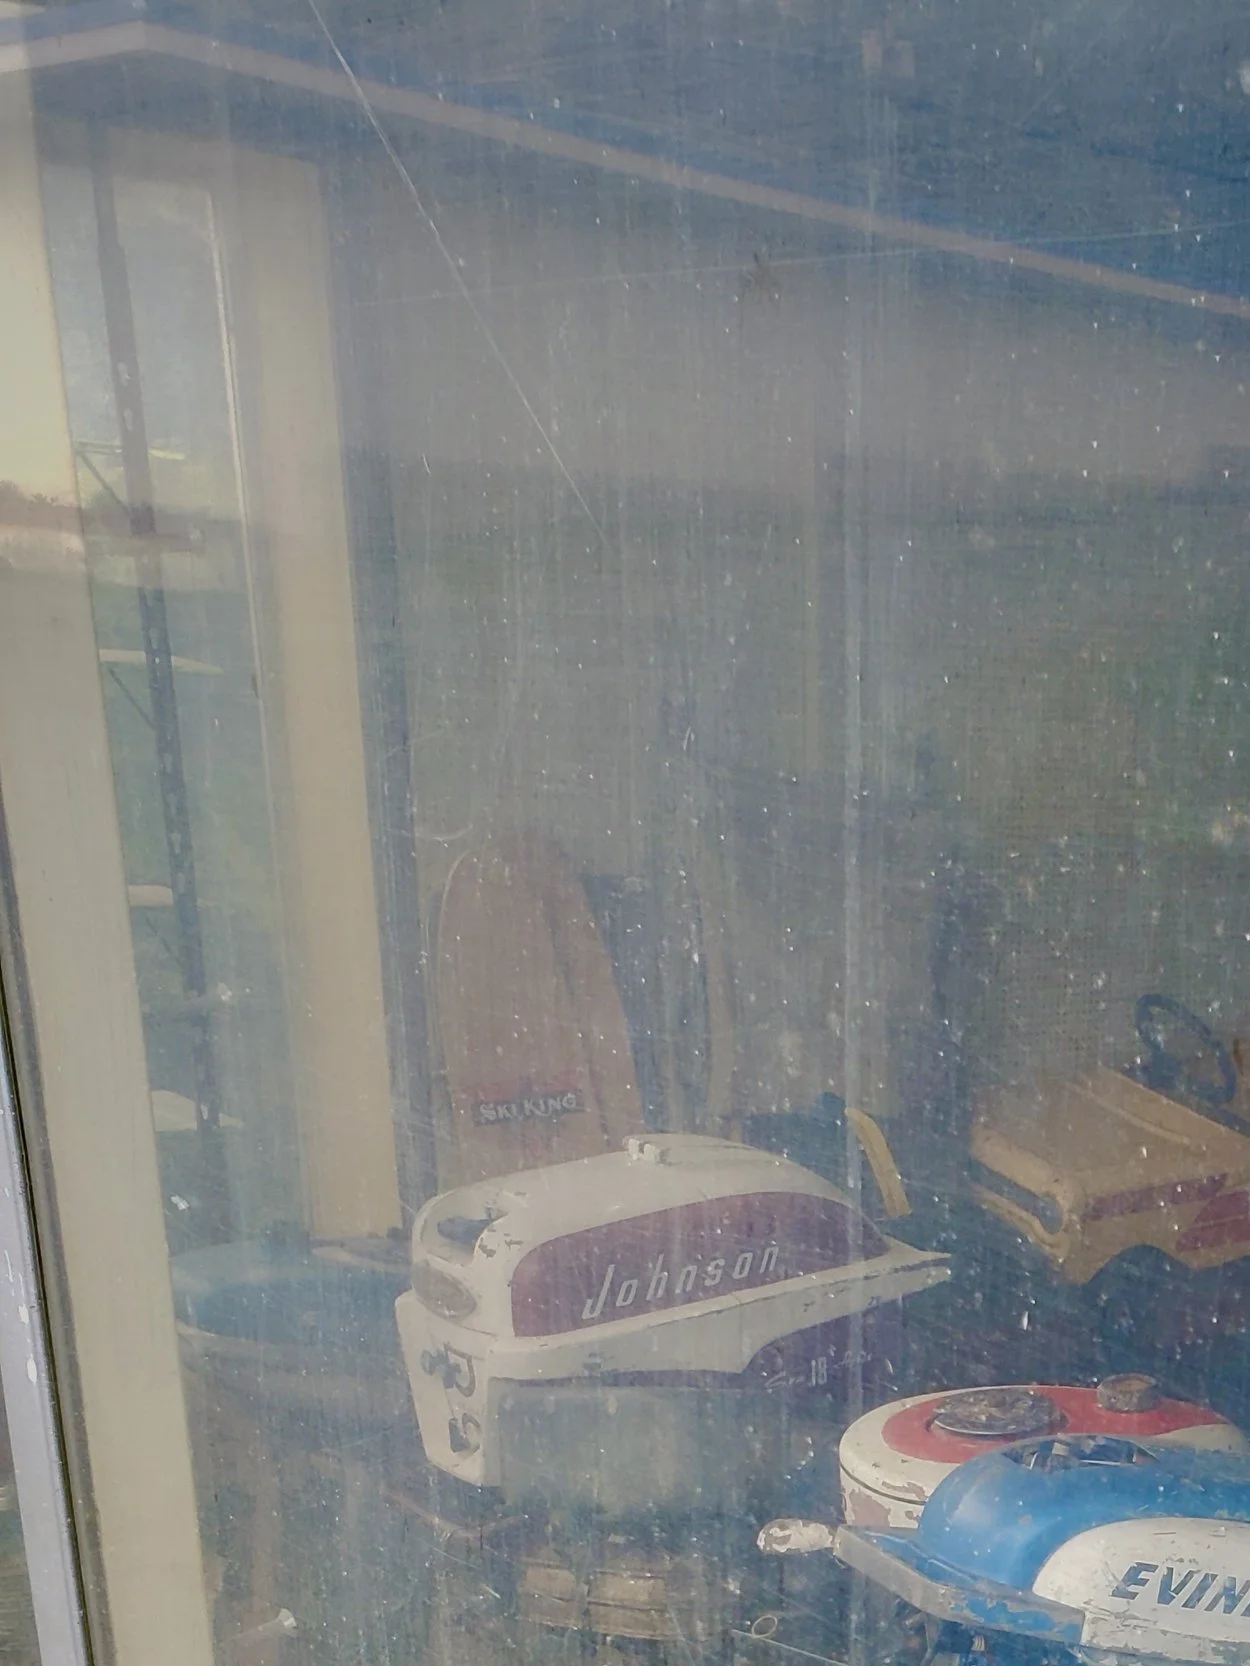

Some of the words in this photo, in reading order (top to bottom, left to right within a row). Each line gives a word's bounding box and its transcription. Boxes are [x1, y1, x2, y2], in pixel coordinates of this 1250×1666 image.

[479, 1103, 517, 1121] SKI
[523, 1092, 577, 1117] KING
[581, 1246, 780, 1320] Johnson
